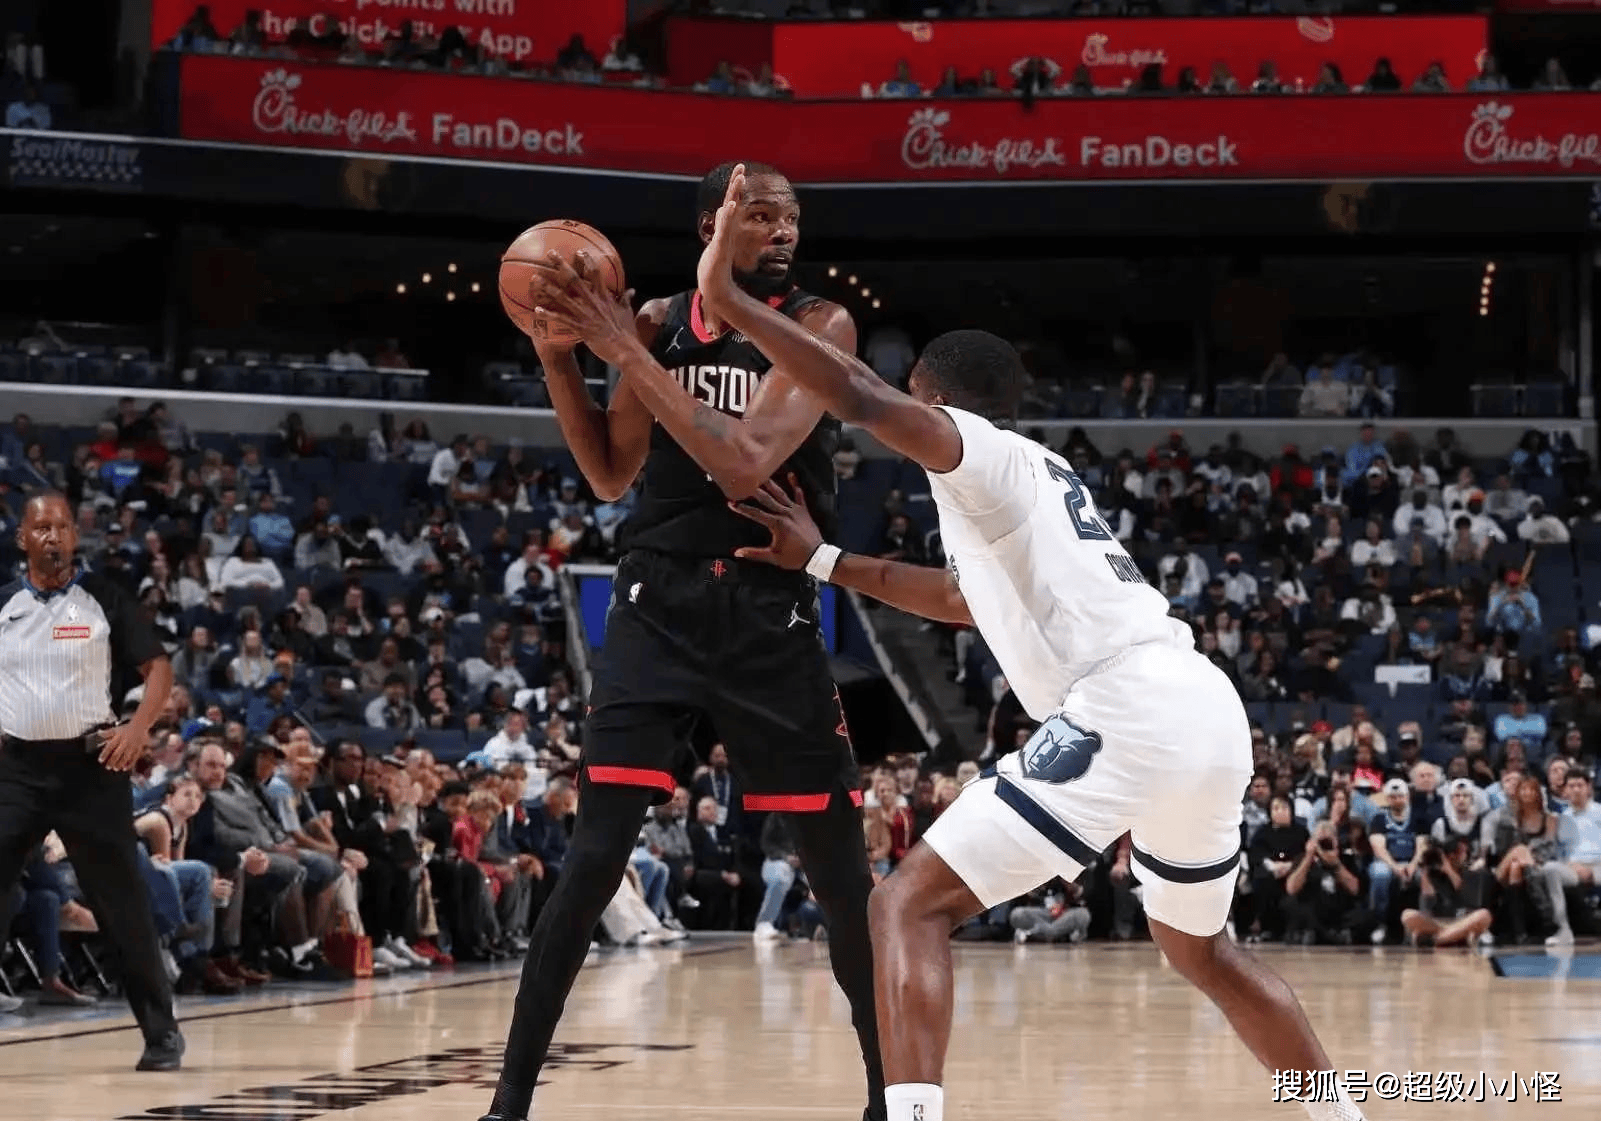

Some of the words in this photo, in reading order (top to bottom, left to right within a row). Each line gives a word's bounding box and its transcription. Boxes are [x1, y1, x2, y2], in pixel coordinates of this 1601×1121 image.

[431, 112, 584, 154] FanDeck
[1080, 135, 1239, 167] FanDeck
[1044, 457, 1114, 541] 2
